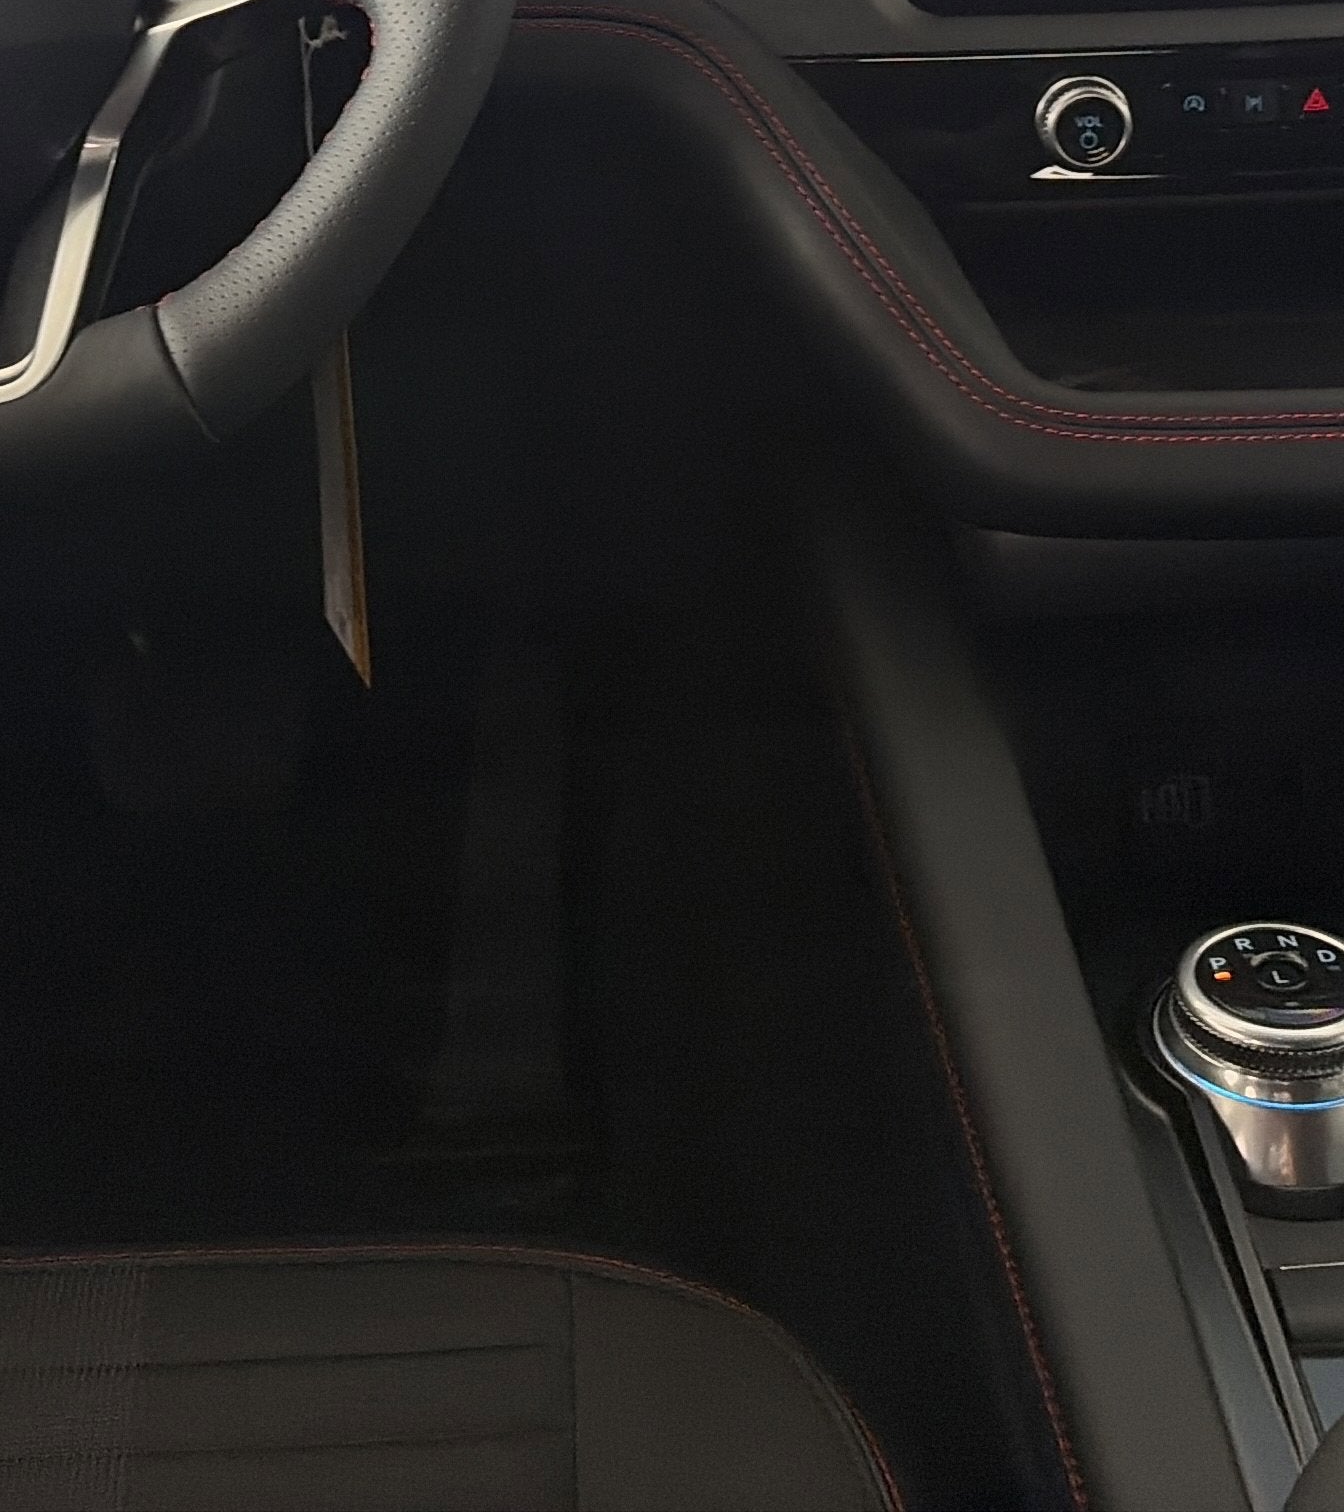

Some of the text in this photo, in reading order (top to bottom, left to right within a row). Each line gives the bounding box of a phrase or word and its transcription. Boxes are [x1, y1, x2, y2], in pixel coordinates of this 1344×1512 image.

[1074, 116, 1104, 128] VOL
[1209, 935, 1337, 970] P R N D
[1271, 970, 1290, 984] L
